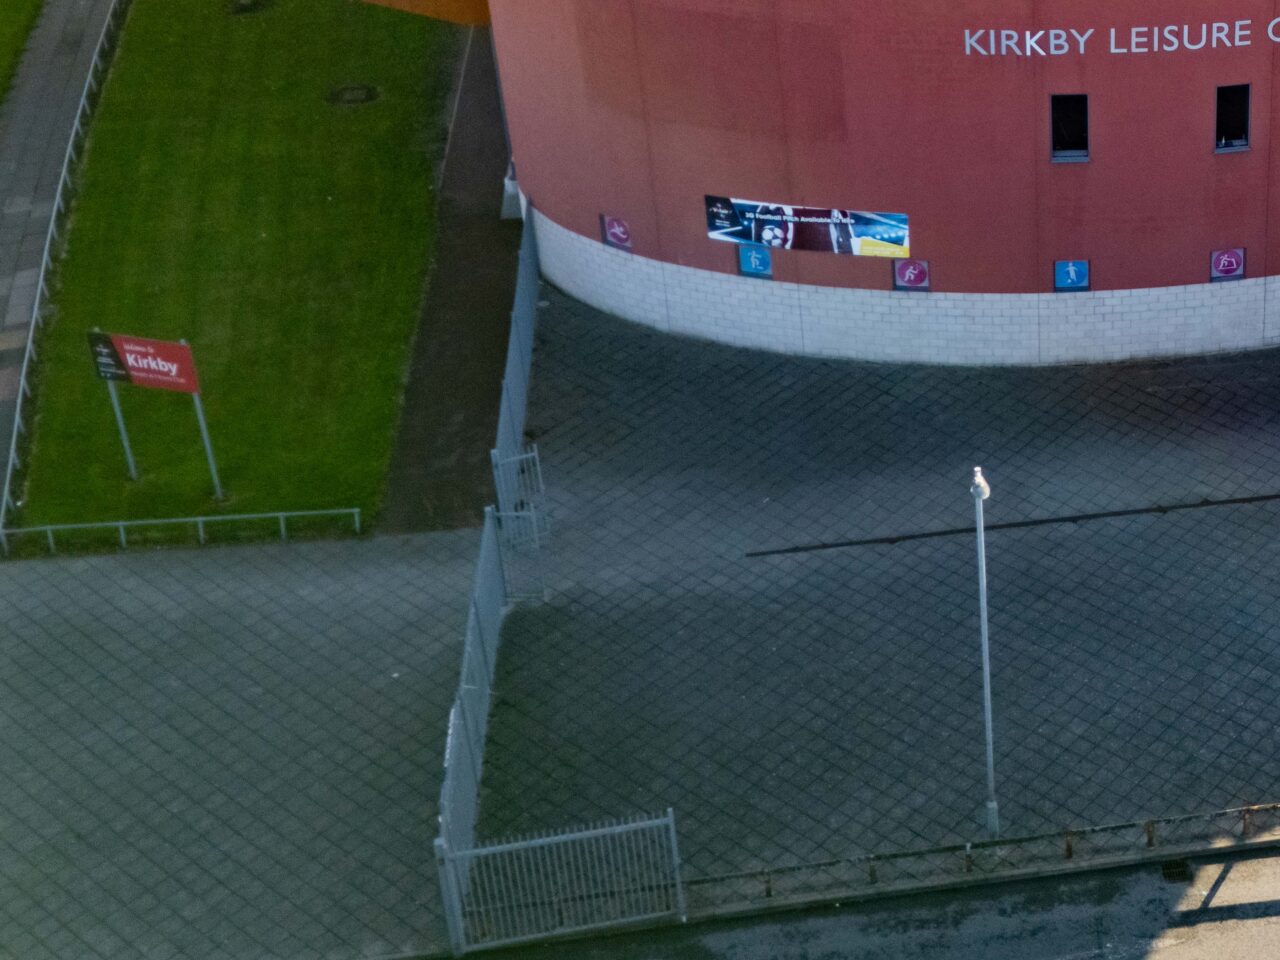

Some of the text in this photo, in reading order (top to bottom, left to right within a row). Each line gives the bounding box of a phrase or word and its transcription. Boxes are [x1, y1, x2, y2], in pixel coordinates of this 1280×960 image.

[963, 28, 1095, 56] KIRKBY
[1109, 19, 1252, 54] LEISURE
[126, 354, 178, 377] Kirkby
